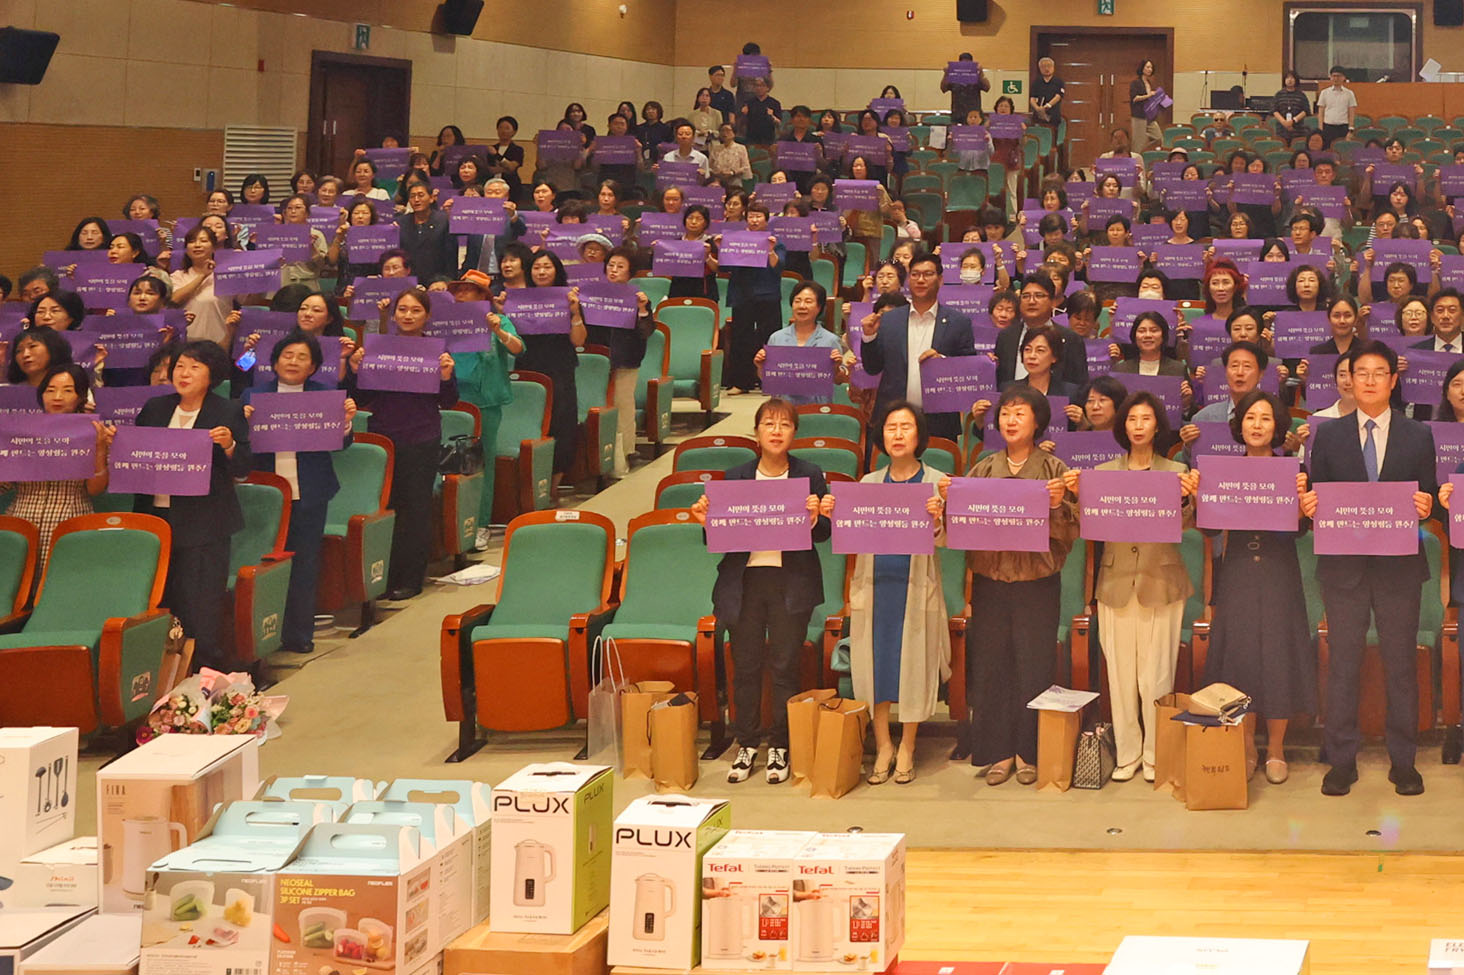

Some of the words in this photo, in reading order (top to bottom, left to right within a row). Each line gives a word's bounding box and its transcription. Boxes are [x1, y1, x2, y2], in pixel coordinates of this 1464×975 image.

[616, 828, 692, 848] PLUX
[708, 863, 744, 873] Tefal
[798, 865, 834, 875] Tefal
[280, 879, 313, 887] NEOSEAL
[280, 887, 313, 896] SILICONE
[314, 888, 338, 896] ZIPPER
[339, 888, 356, 897] BAG
[289, 896, 301, 904] SET
